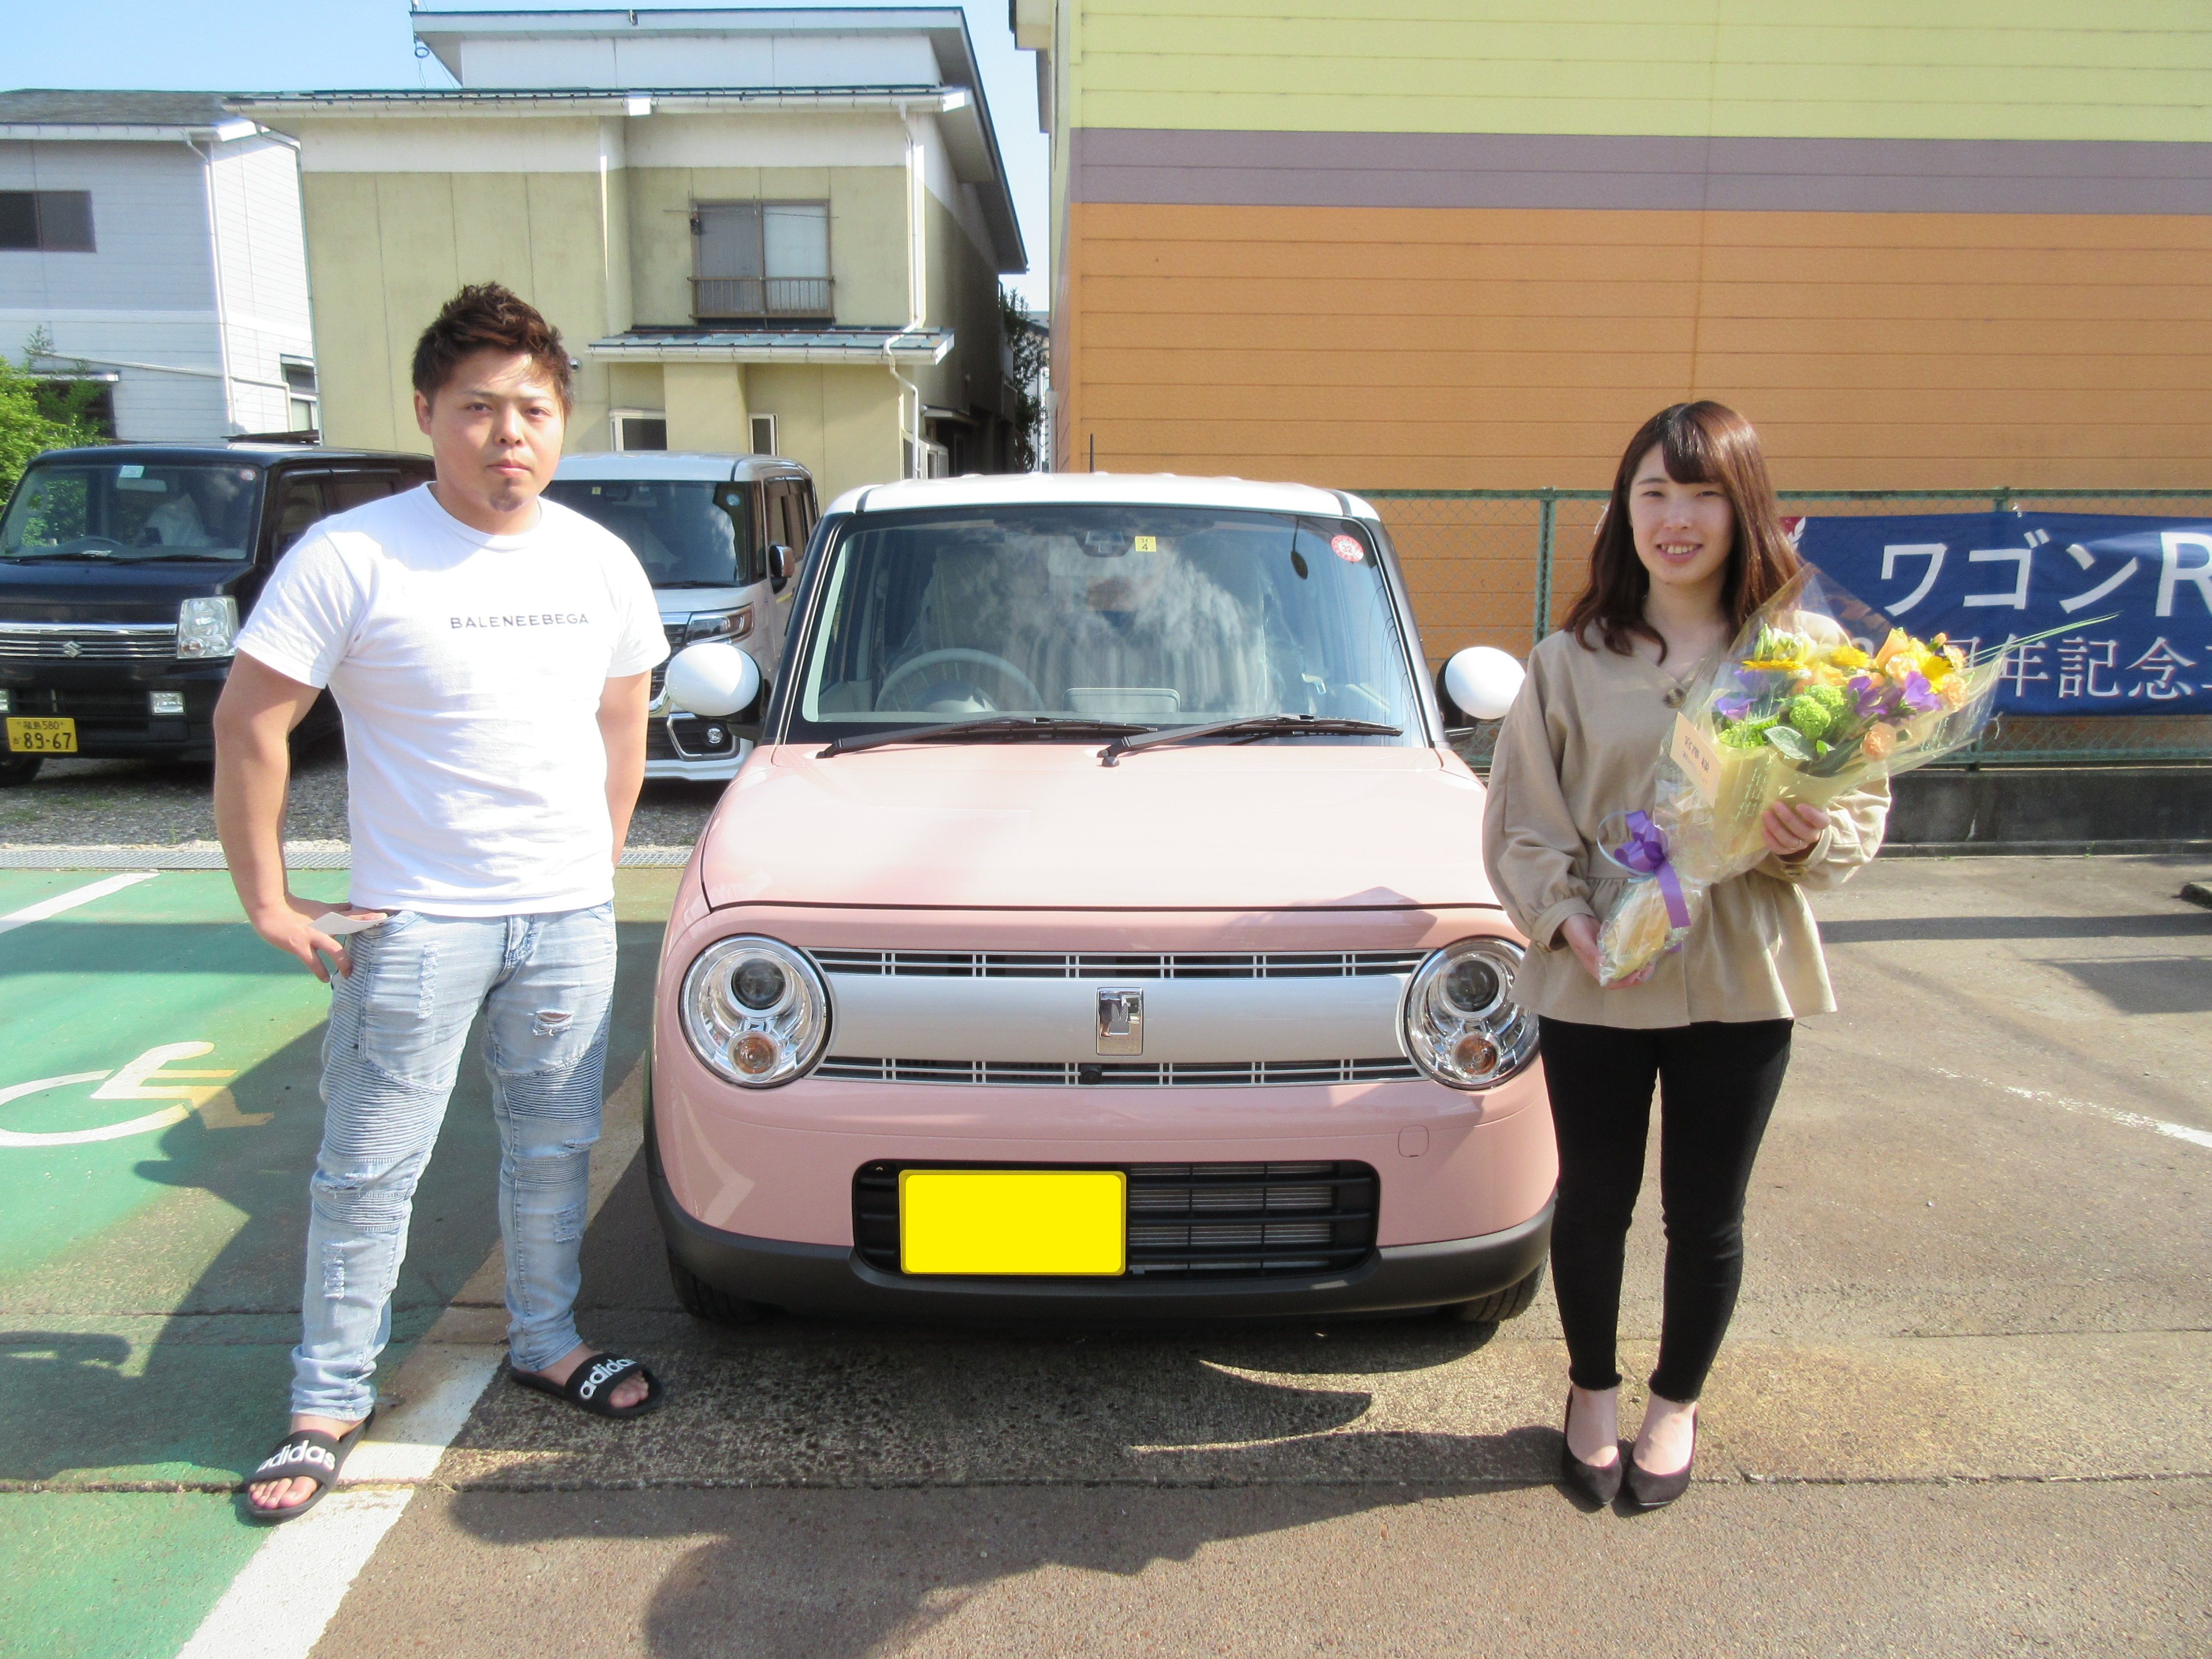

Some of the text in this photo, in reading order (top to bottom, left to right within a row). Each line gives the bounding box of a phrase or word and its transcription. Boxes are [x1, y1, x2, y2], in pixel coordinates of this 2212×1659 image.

[1342, 544, 1353, 553] 32
[450, 613, 589, 629] BALENEEBEGA
[24, 732, 71, 749] 89-67
[579, 1358, 637, 1399] adida
[255, 1440, 336, 1473] adidas
